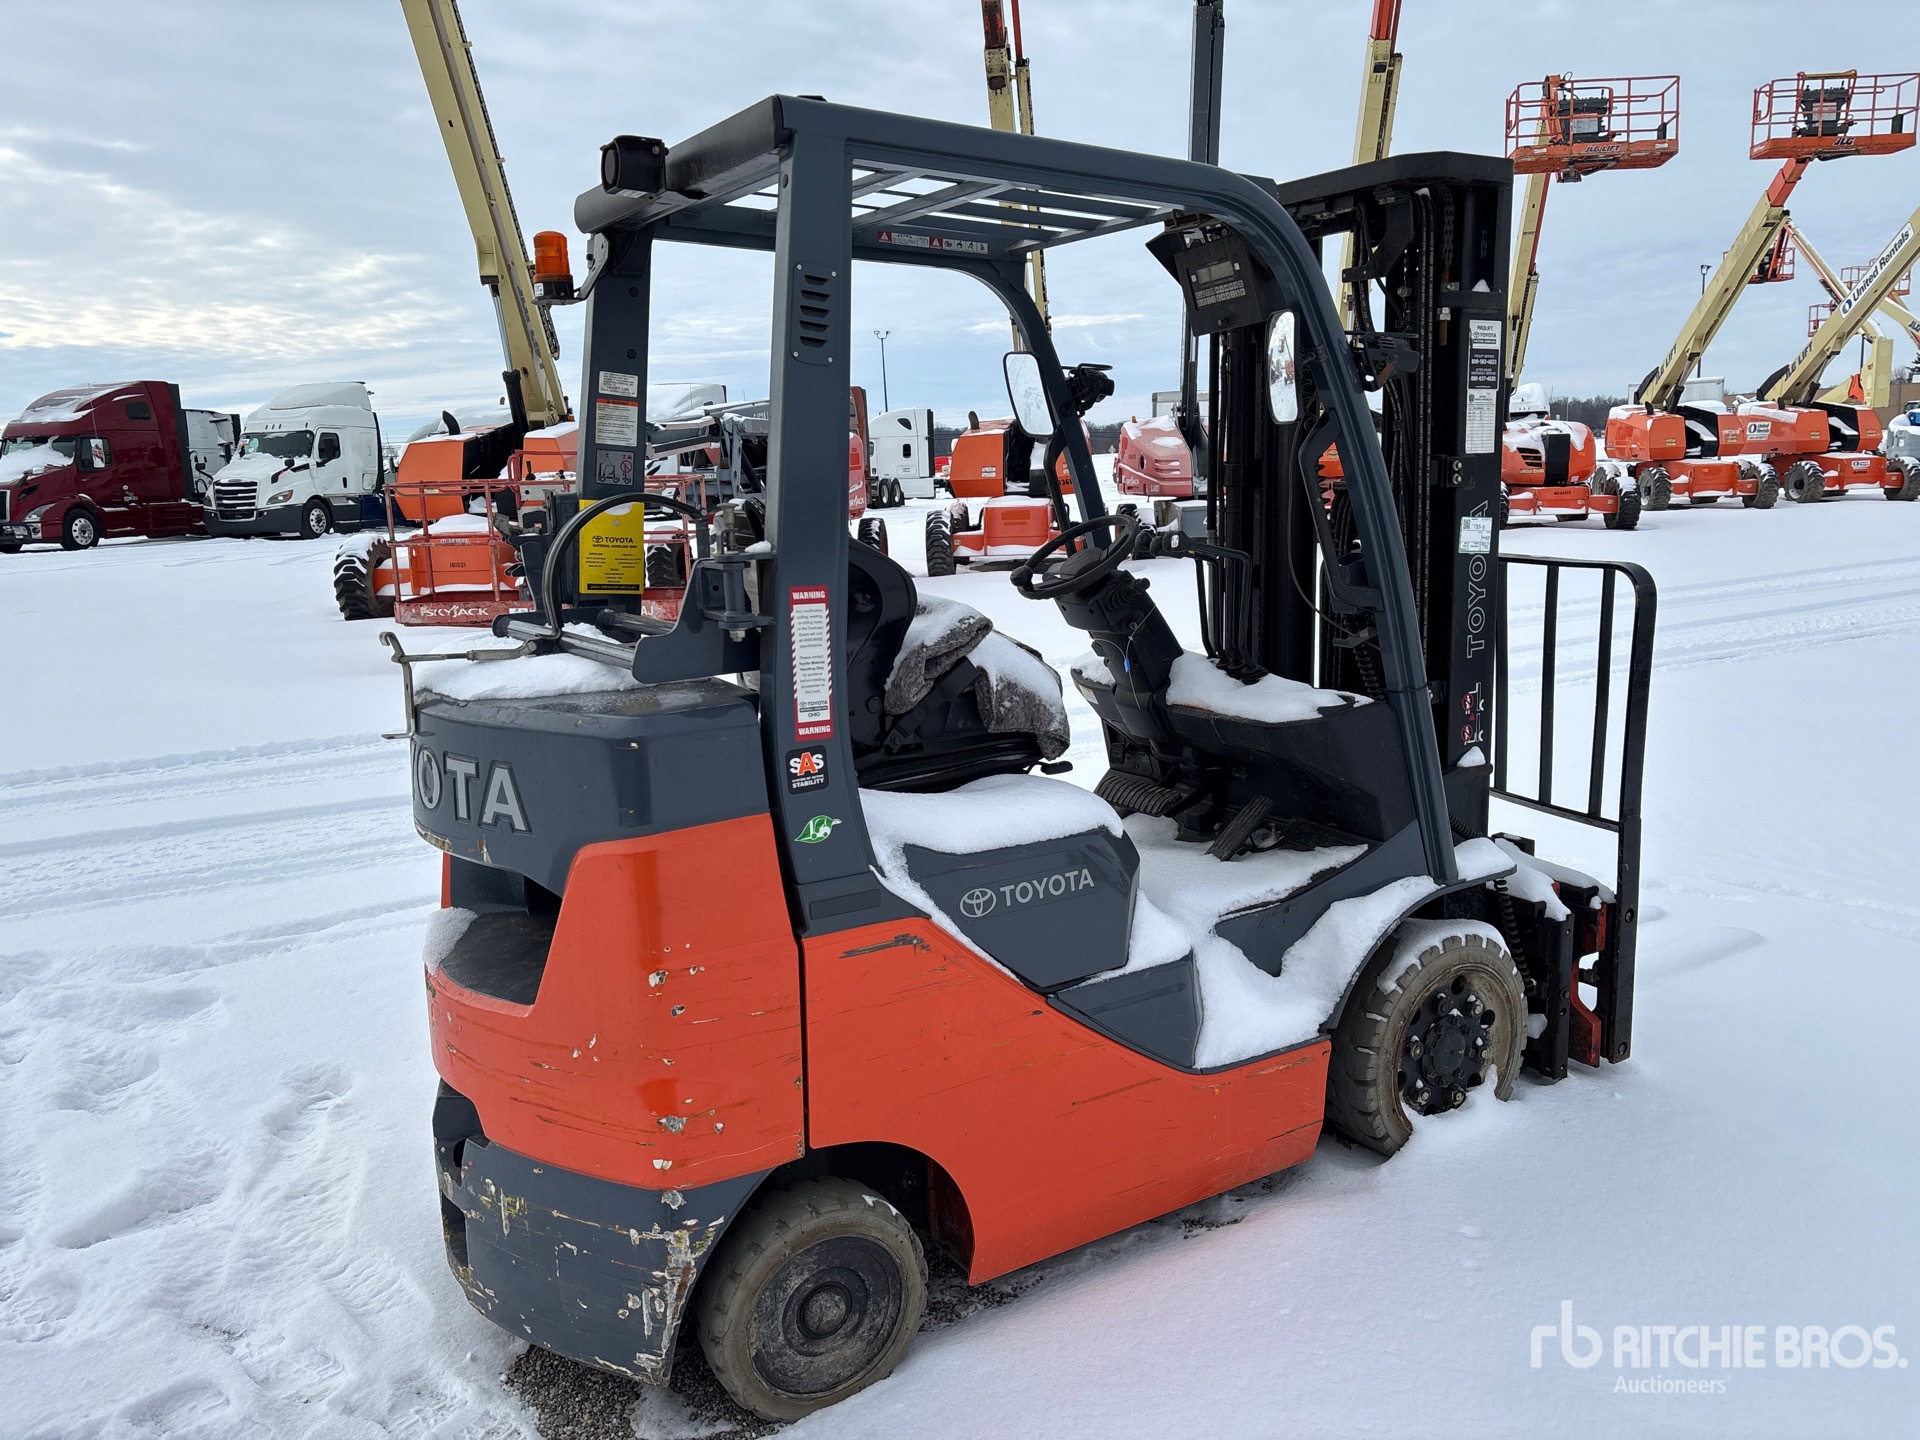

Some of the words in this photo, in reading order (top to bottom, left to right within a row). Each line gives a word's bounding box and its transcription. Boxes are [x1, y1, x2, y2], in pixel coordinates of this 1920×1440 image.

[1834, 137, 1856, 146] JLG
[1852, 265, 1878, 302] United
[1880, 230, 1910, 270] Rentals
[1798, 341, 1812, 365] LIFT
[1467, 500, 1488, 658] TOYOA
[792, 591, 825, 600] WARNING
[426, 605, 489, 618] SKYJACK
[798, 725, 831, 735] WARNING
[790, 752, 824, 776] SAS
[413, 746, 533, 834] OTA
[792, 778, 824, 788] STABILITY
[1000, 868, 1094, 906] TOYOTA
